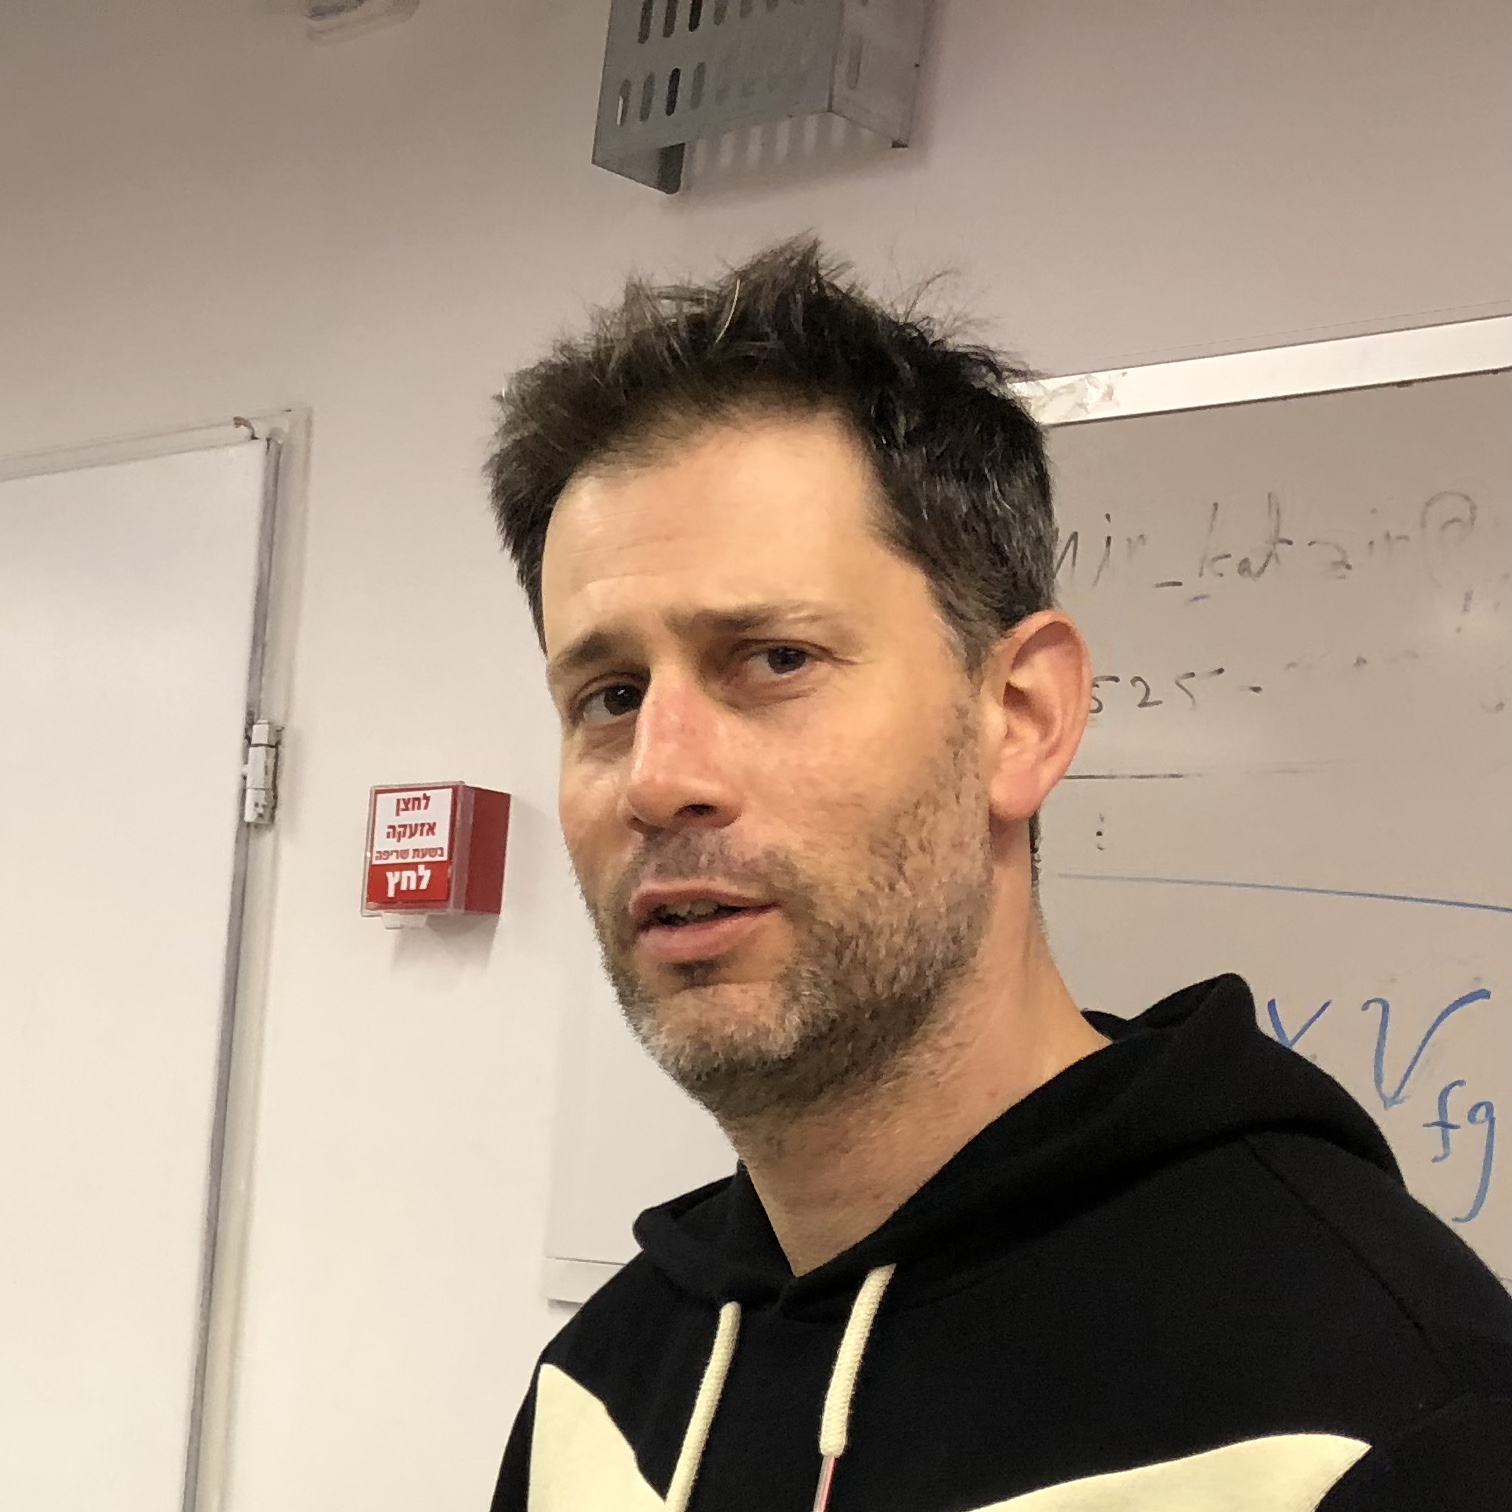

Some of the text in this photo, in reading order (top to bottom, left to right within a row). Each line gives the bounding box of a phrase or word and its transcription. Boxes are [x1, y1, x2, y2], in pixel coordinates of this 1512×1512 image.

[396, 793, 430, 816] לחצן
[386, 822, 436, 842] אזעקה
[375, 847, 444, 861] בשעת שריפה
[386, 864, 431, 897] לחץ
